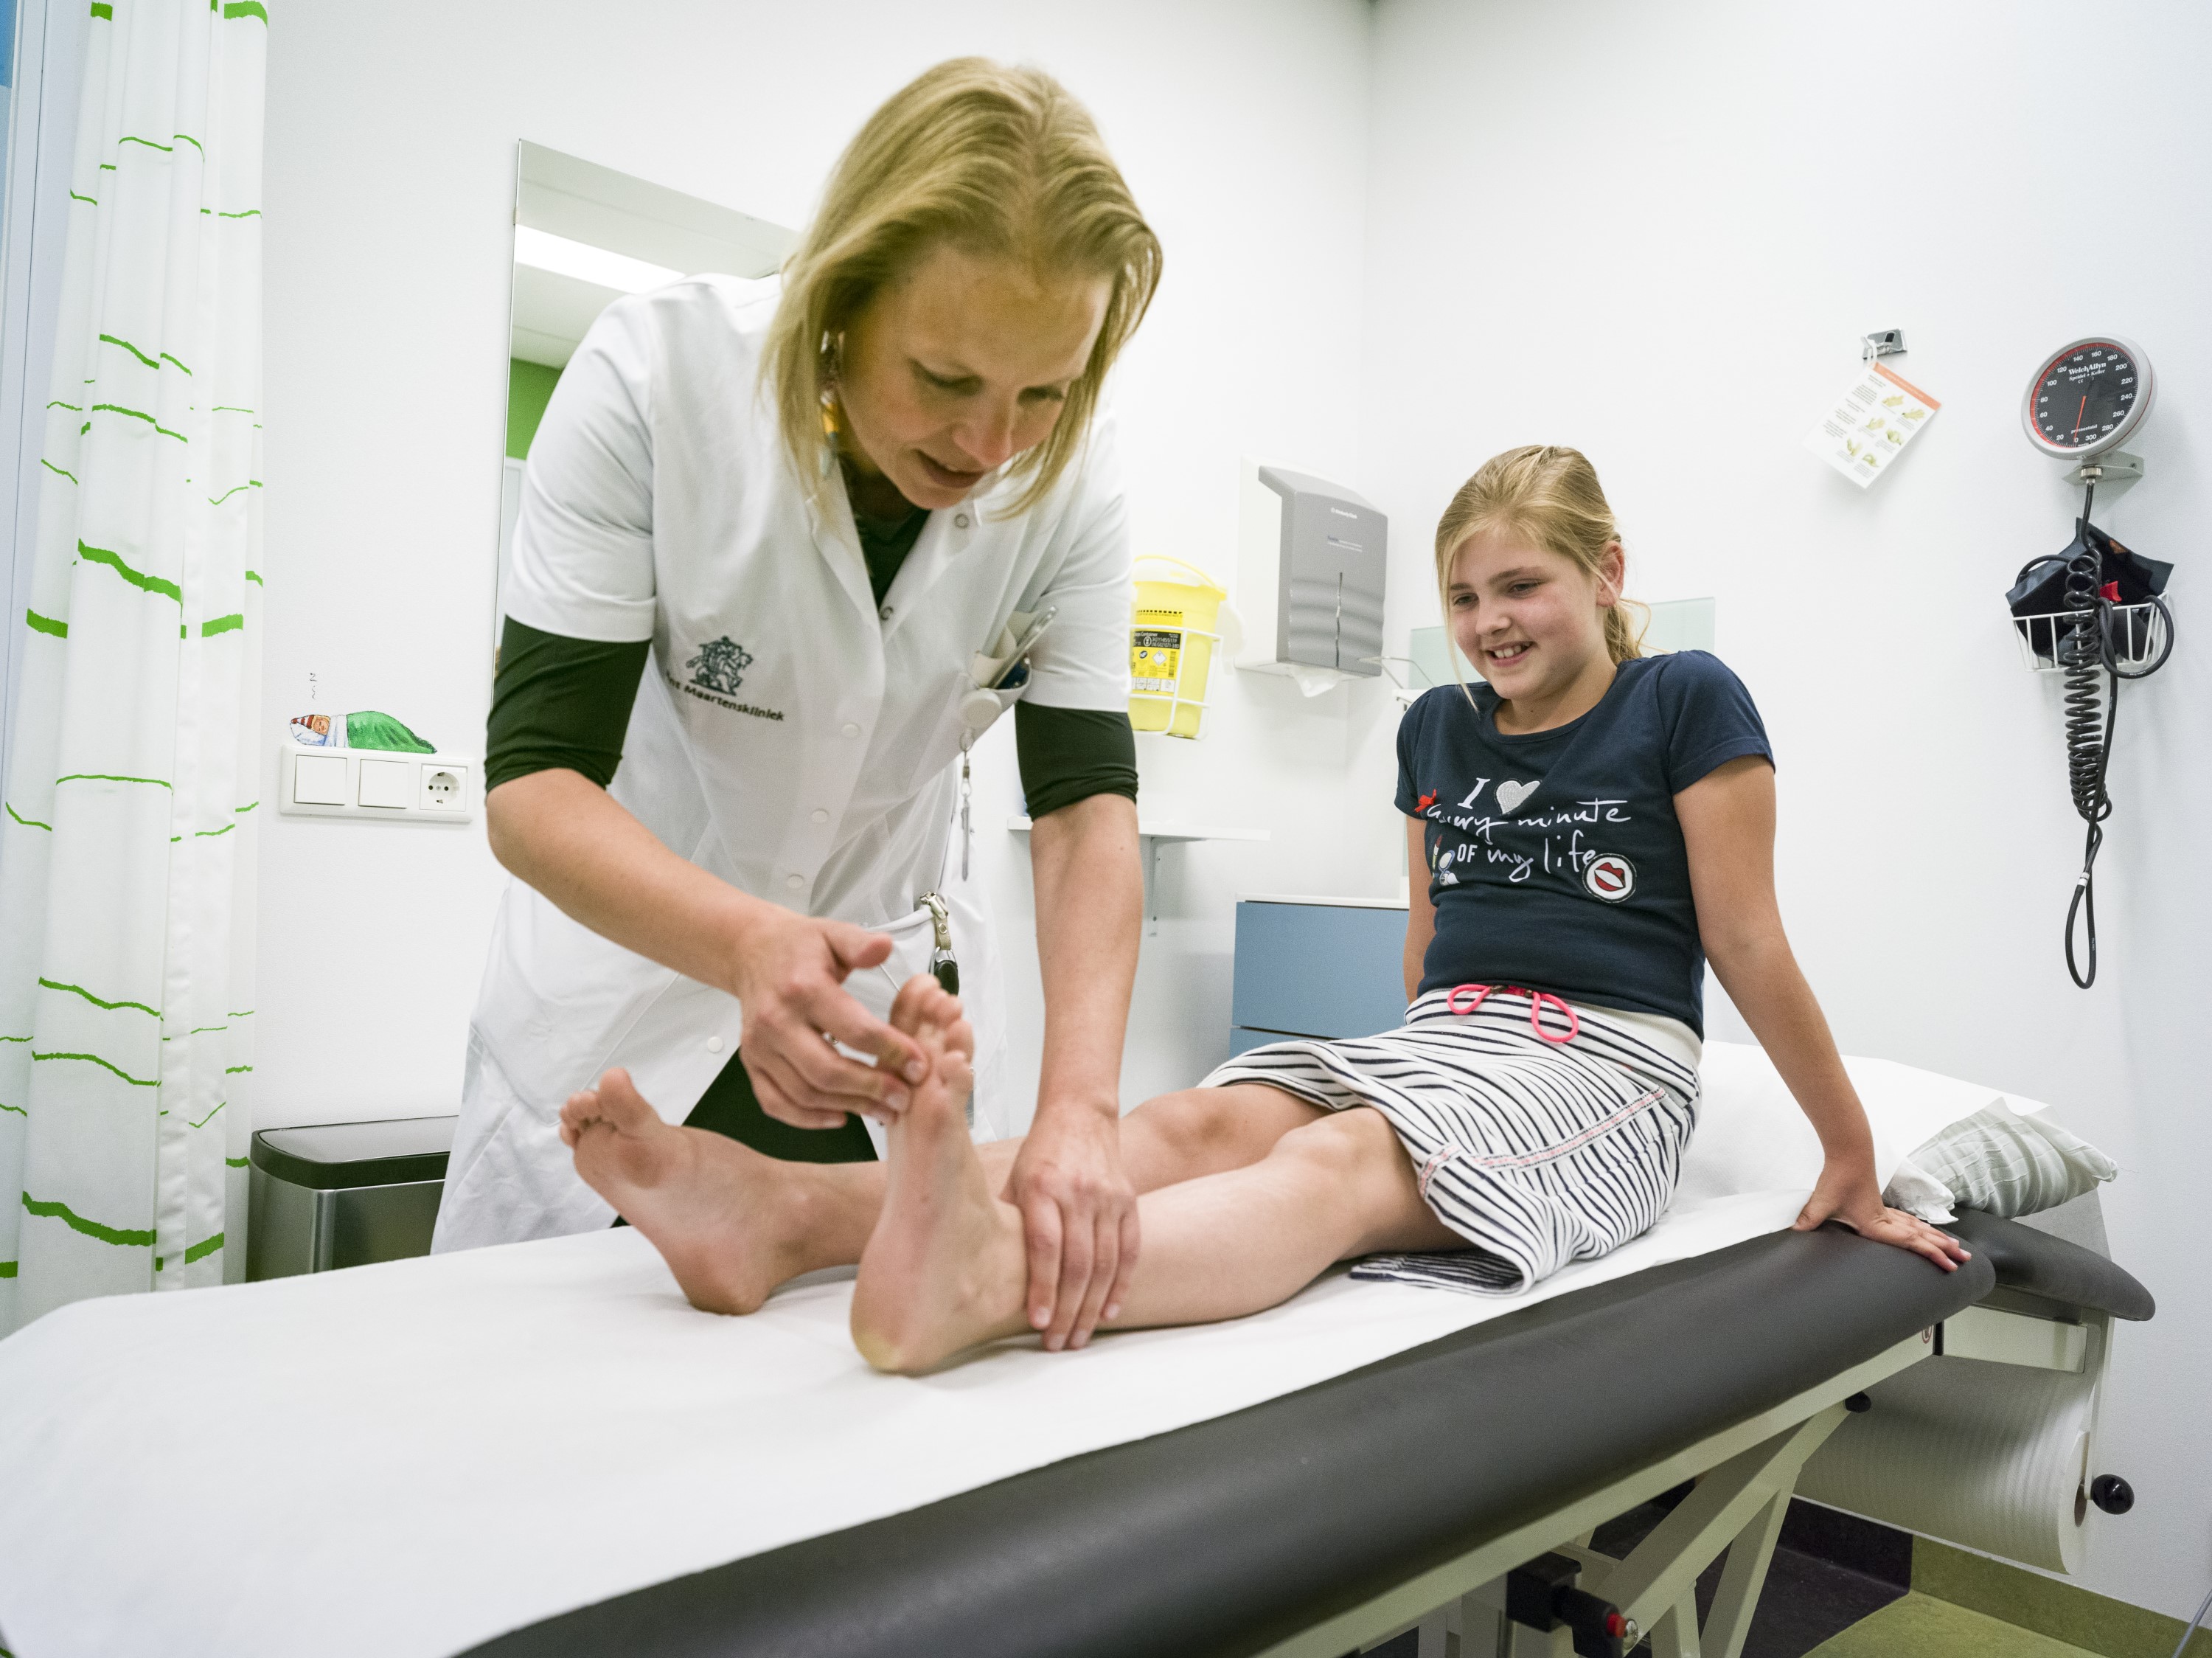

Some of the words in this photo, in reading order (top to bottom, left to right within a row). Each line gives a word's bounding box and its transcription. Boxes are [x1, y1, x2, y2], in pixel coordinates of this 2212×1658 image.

[2115, 363, 2127, 371] 200
[2121, 377, 2133, 385] 220
[2101, 423, 2113, 431] 280
[684, 685, 785, 721] Maartenskliniek
[1457, 777, 1491, 810] I
[1517, 797, 1632, 828] minute
[1457, 843, 1478, 863] OF
[1487, 848, 1534, 883] my
[1545, 829, 1597, 873] life
